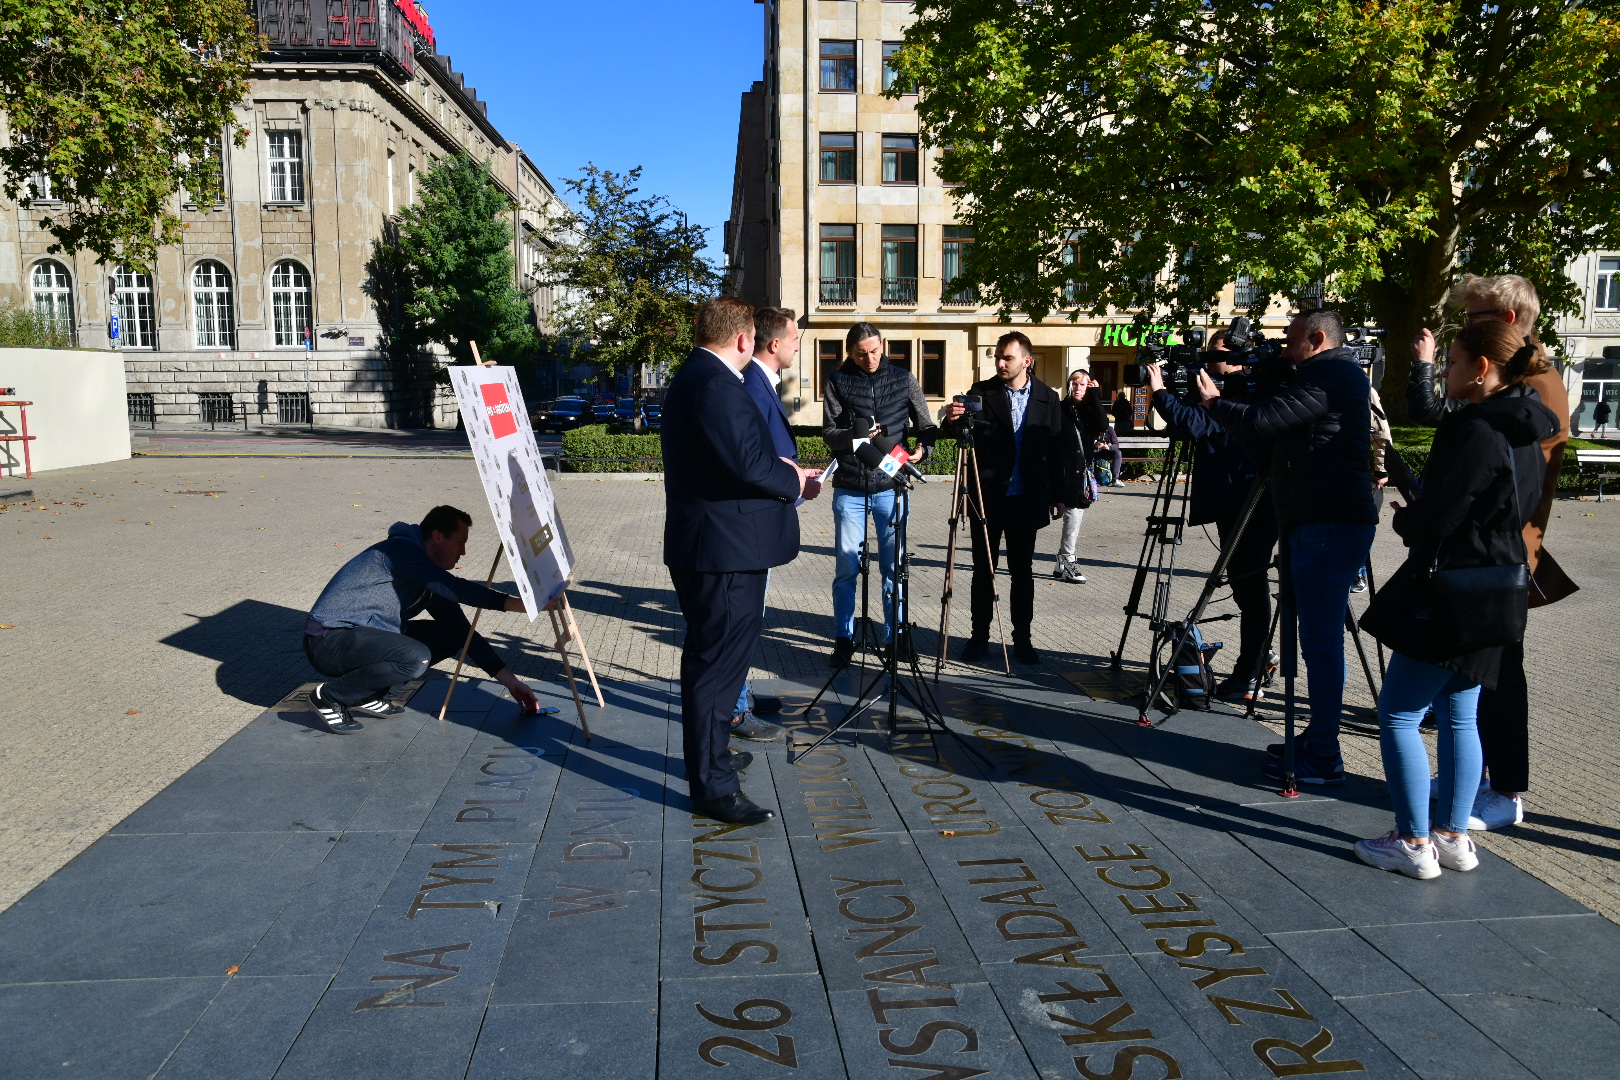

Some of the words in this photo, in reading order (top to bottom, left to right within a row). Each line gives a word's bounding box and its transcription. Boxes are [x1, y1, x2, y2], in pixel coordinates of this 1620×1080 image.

[454, 746, 546, 824] PLACU
[562, 786, 641, 862] DNIU
[405, 843, 507, 919] TYM
[547, 881, 629, 919] W
[354, 941, 472, 1014] NA
[695, 999, 799, 1070] 26
